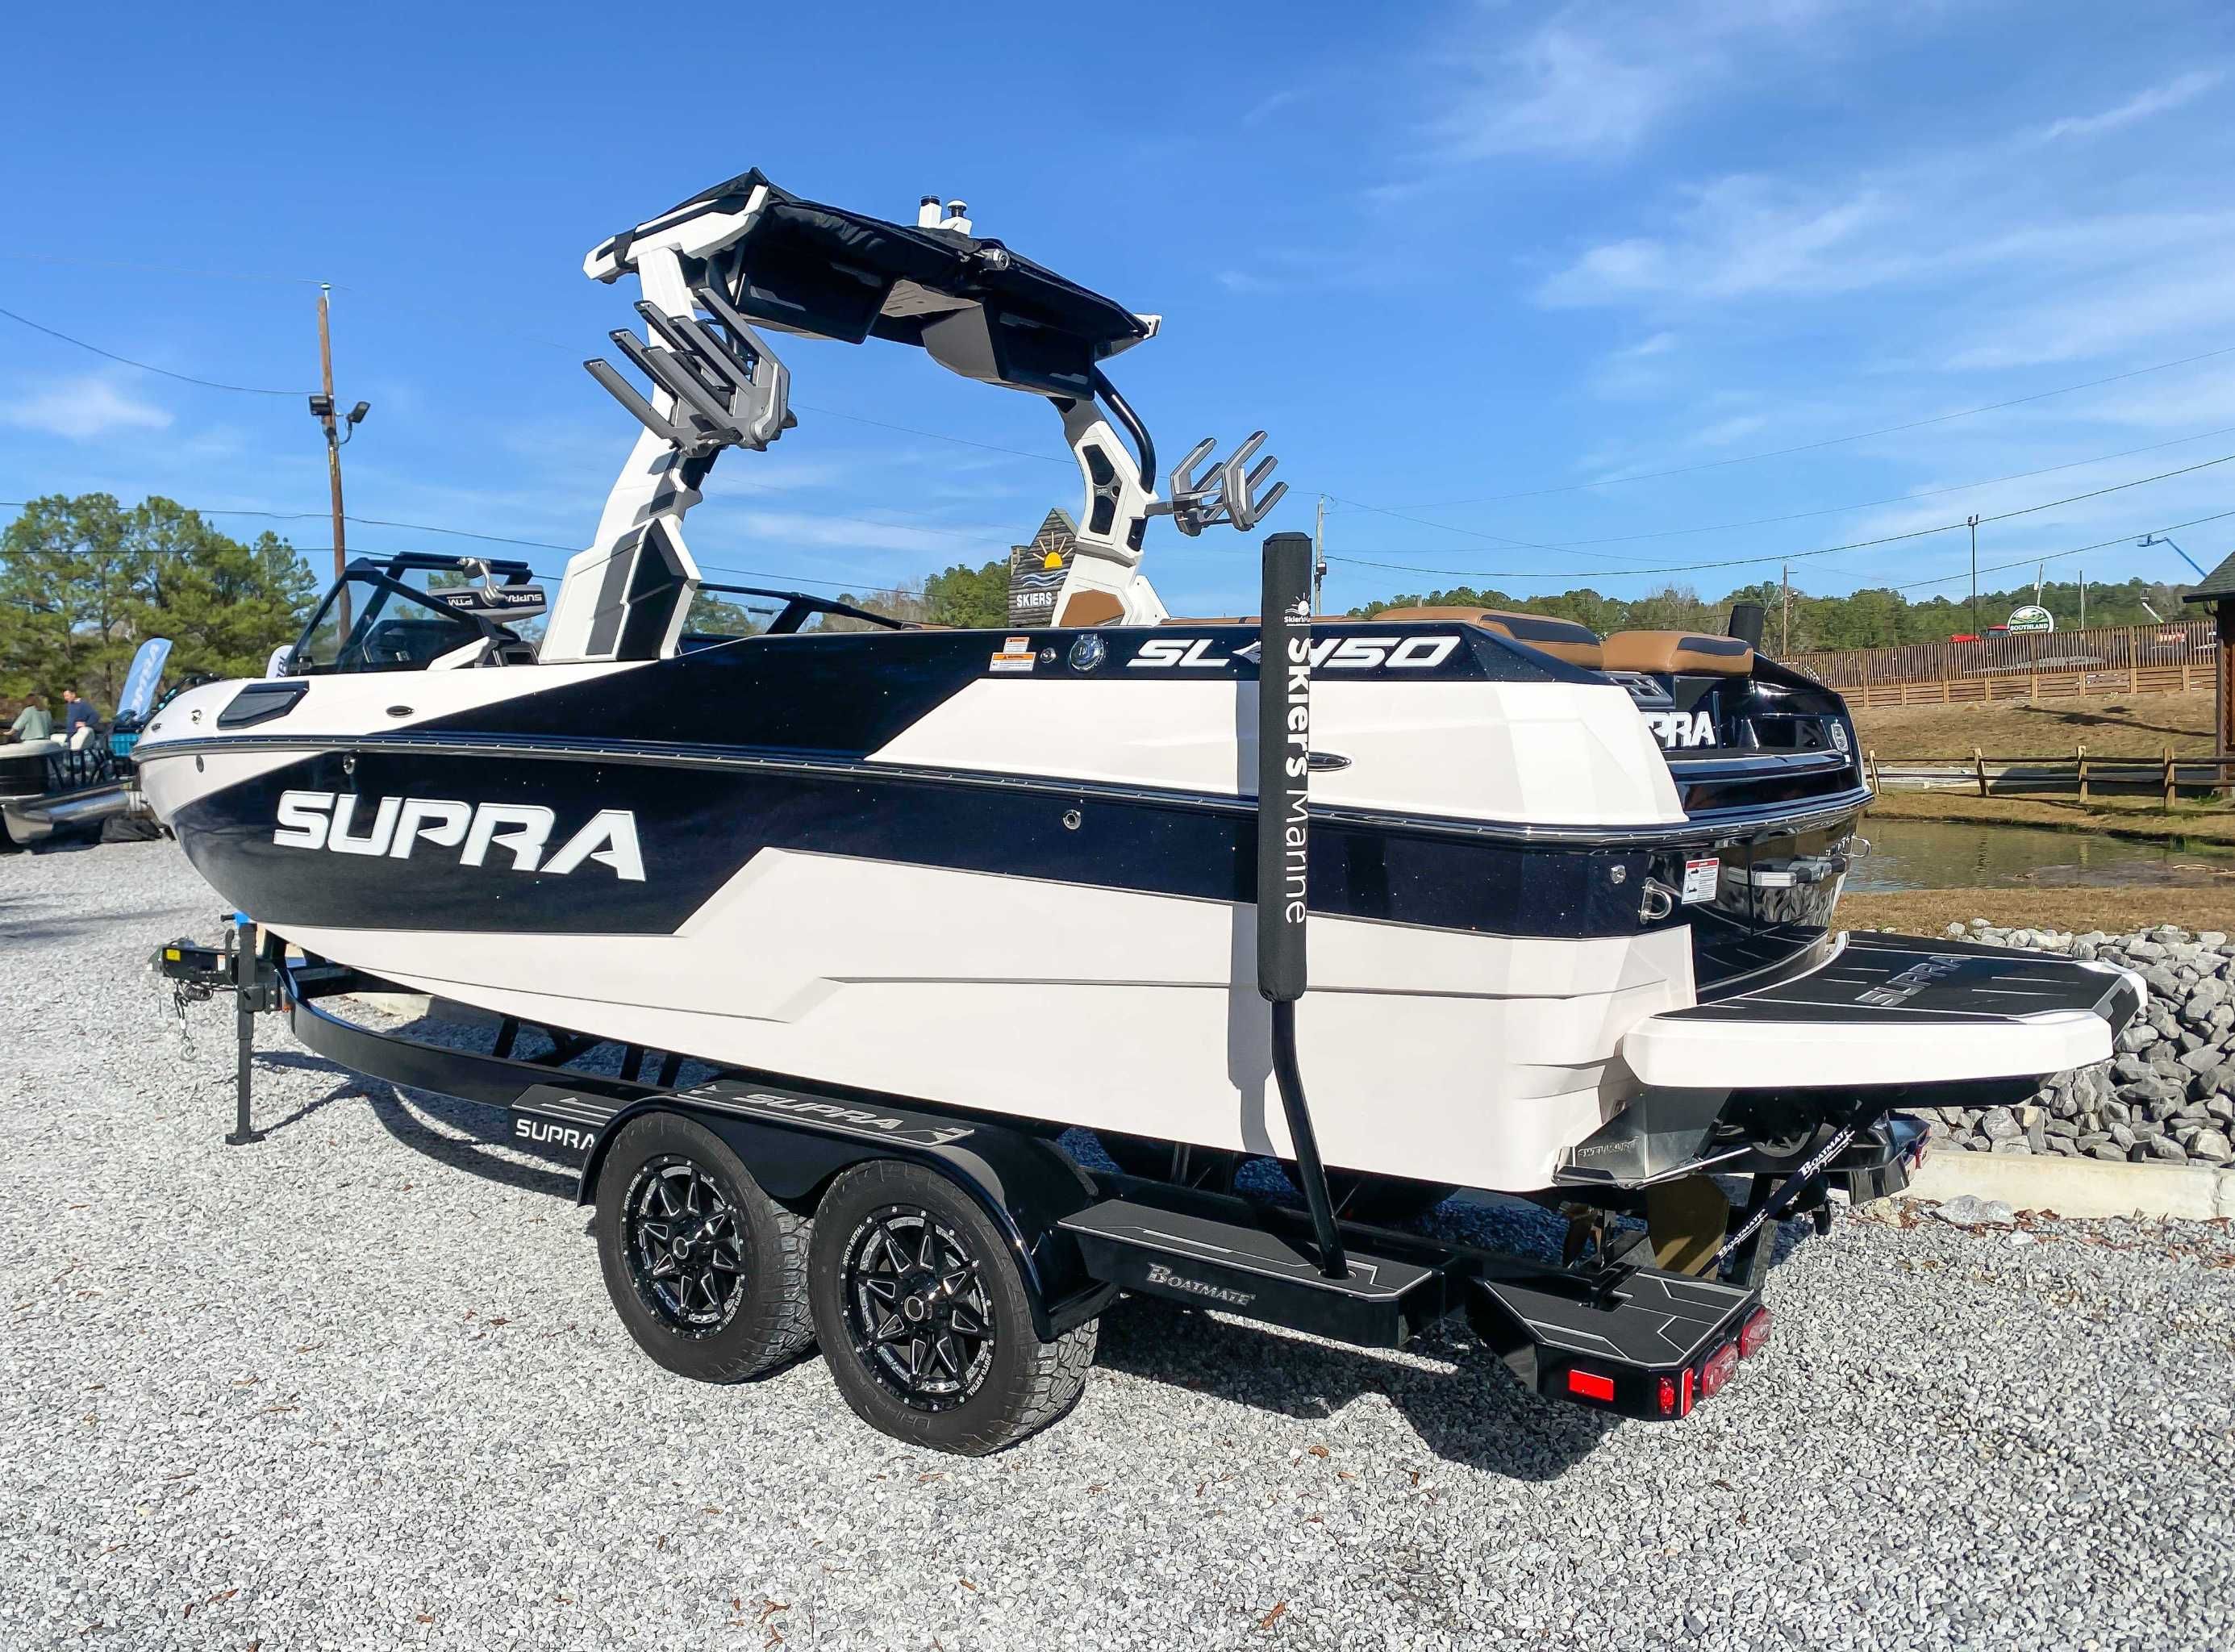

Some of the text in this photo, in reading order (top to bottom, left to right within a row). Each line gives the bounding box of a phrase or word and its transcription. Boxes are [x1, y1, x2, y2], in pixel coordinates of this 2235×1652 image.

[1016, 592, 1053, 607] SKIERS
[2010, 623, 2049, 631] SOUTHLAND
[1127, 639, 1230, 668] SL
[274, 790, 646, 882] SUPRA
[1285, 790, 1308, 924] Marine
[1854, 955, 1972, 1007] SUPRA
[733, 1093, 904, 1129] SUPRA
[515, 1118, 595, 1150] SUPRA
[842, 1224, 865, 1267] MOTO METAL
[968, 1353, 993, 1396] MOTO METAL
